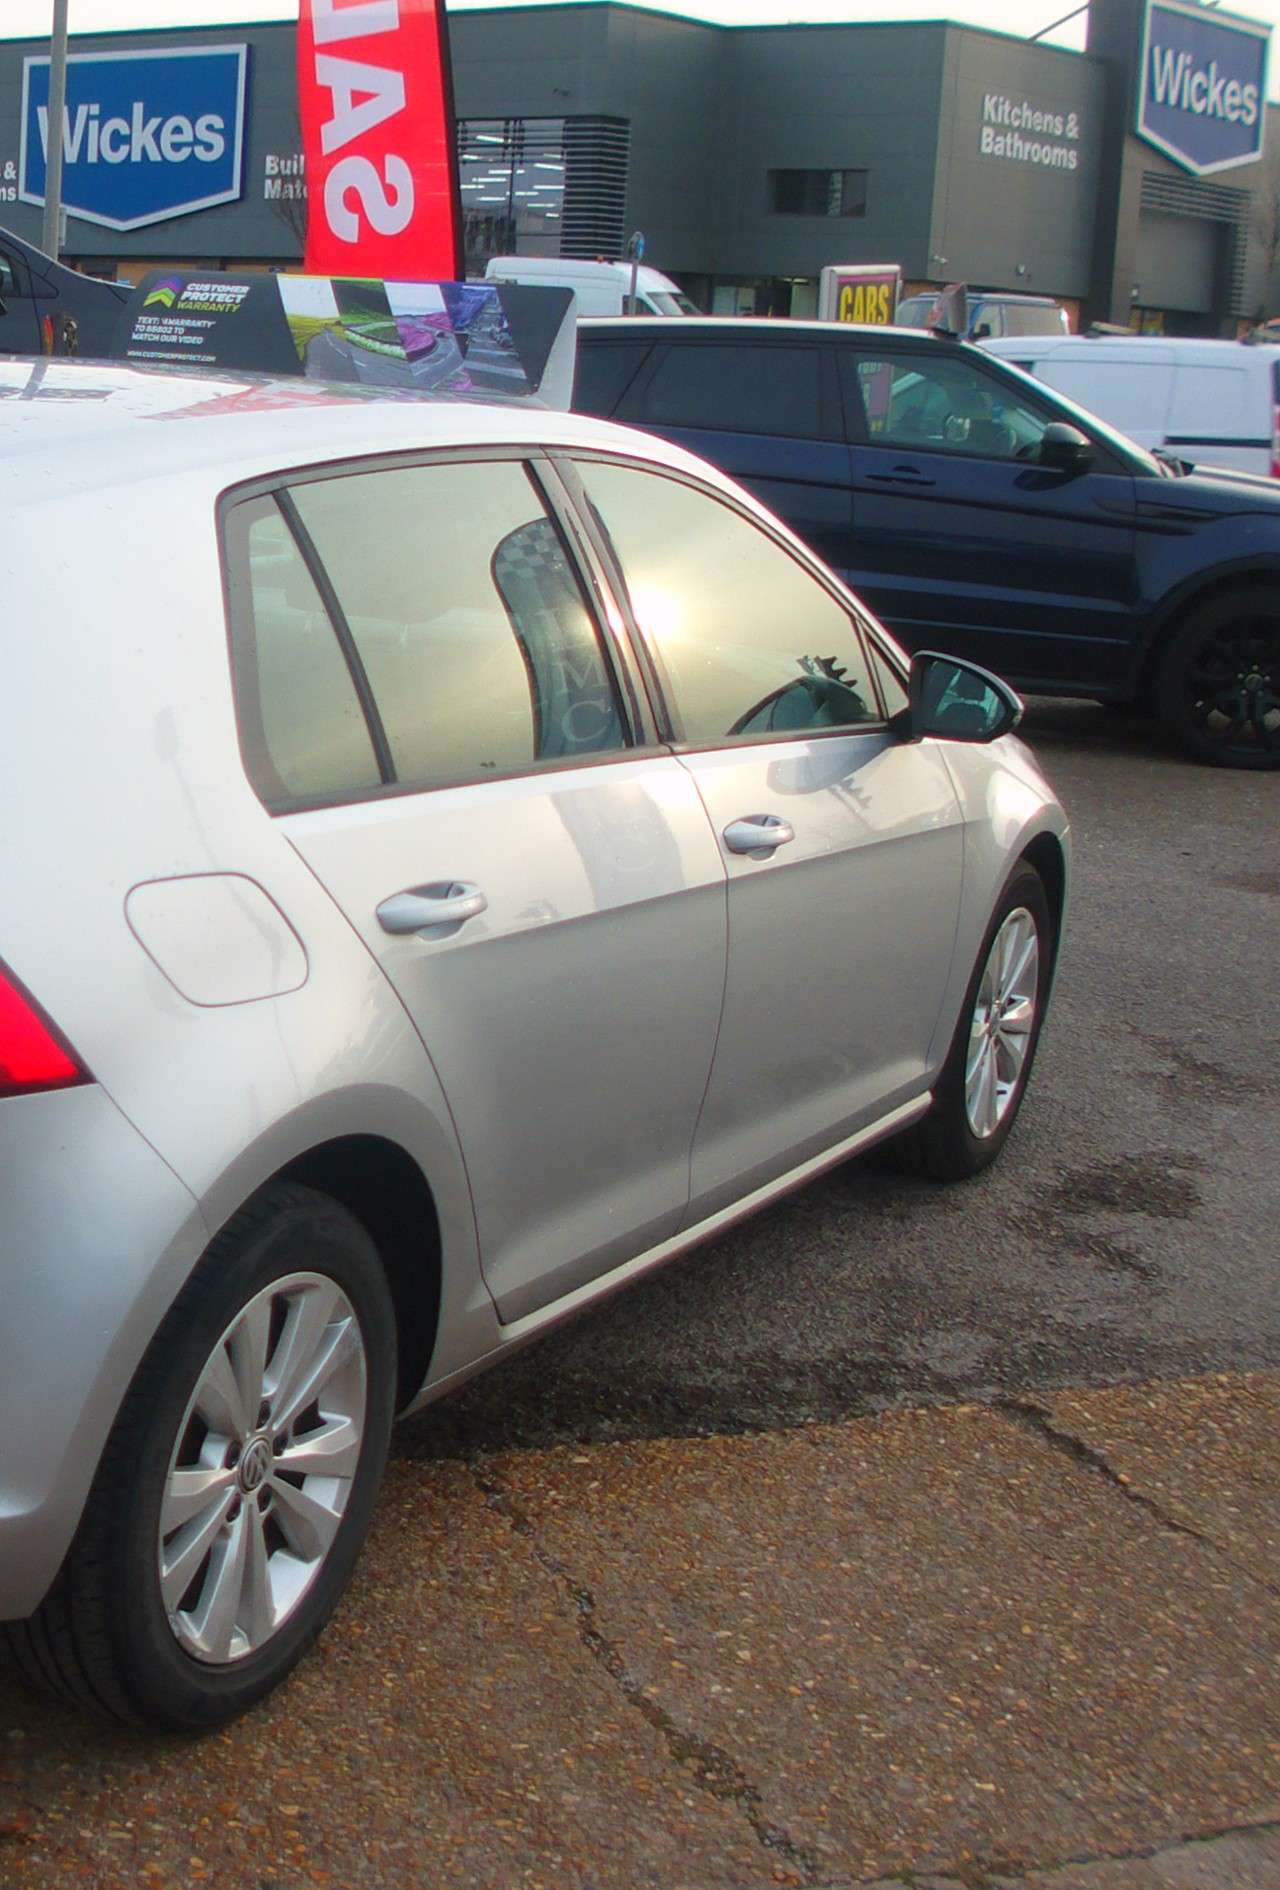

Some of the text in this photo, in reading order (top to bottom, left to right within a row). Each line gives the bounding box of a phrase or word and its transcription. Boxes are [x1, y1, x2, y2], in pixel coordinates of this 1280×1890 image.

[1152, 45, 1258, 126] Wickes
[36, 101, 225, 164] Wickes
[983, 93, 1080, 139] Kitchens &
[980, 125, 1078, 169] Bathrooms
[3, 161, 17, 180] &
[177, 301, 240, 313] WARRANTY
[181, 291, 246, 303] PROTECT
[186, 283, 250, 294] CUSTOMER
[839, 285, 889, 325] CARS
